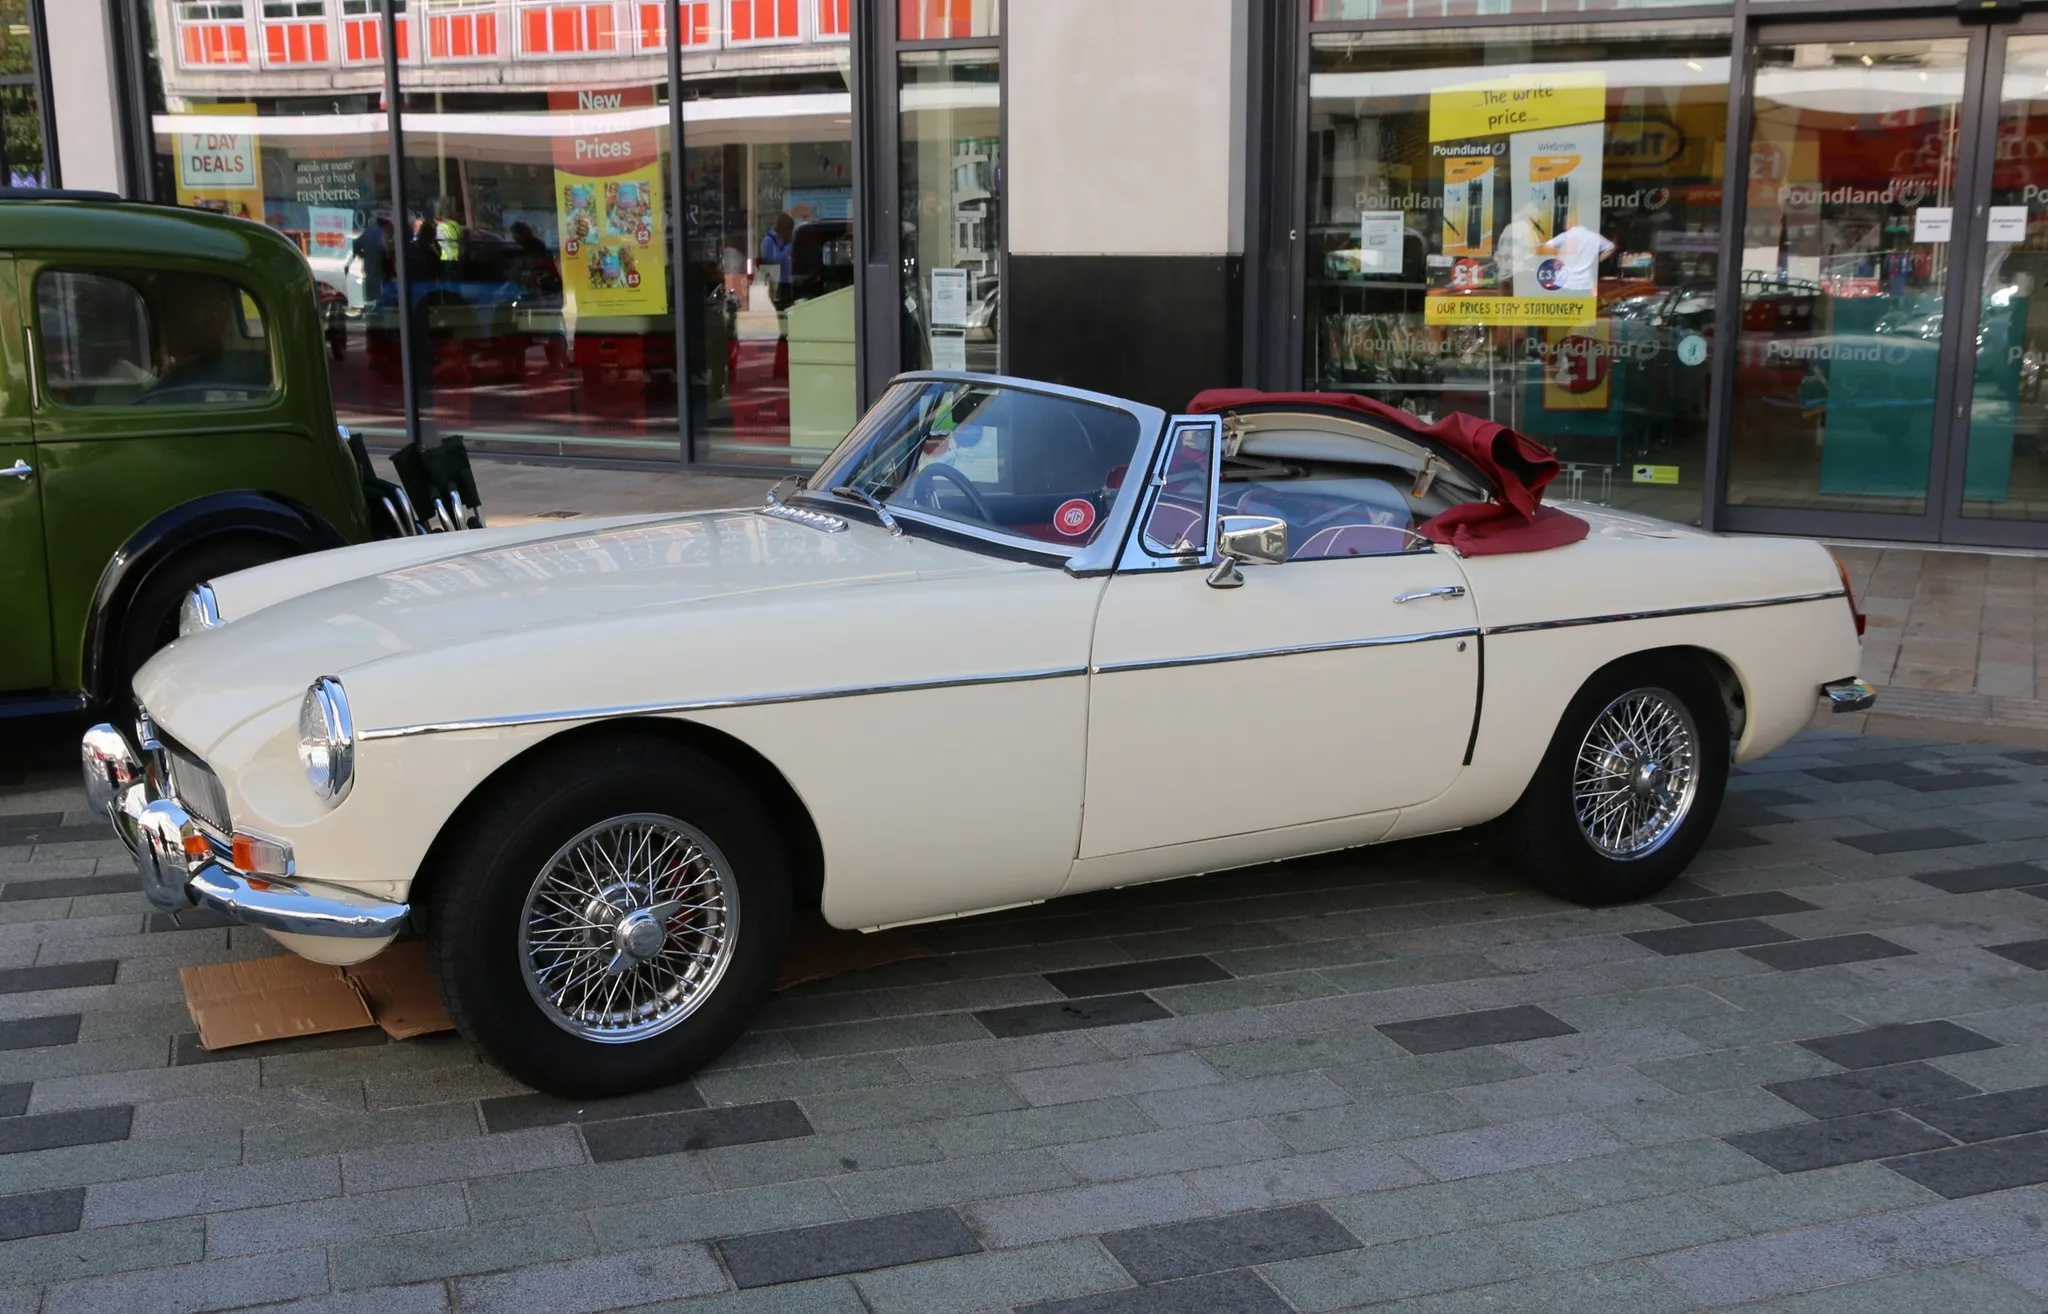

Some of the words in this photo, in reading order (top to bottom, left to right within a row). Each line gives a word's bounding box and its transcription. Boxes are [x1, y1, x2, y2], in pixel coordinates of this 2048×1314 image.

[577, 90, 622, 111] New
[1513, 83, 1554, 101] write
[192, 133, 202, 150] 7
[206, 133, 238, 150] DAY
[575, 137, 632, 159] Prices
[1432, 143, 1490, 156] Poundland
[1537, 141, 1577, 152] WHSmith
[191, 155, 244, 173] DEALS
[296, 172, 312, 185] and
[296, 184, 361, 206] raspberries
[1355, 192, 1444, 210] Poundlan
[1778, 185, 1895, 205] Poundland
[637, 231, 649, 240] £2
[567, 242, 578, 251] £3
[628, 274, 639, 284] £3
[1453, 264, 1480, 285] £1
[1436, 302, 1455, 315] OUR
[1460, 302, 1491, 315] PRICES
[1495, 302, 1521, 315] STAY
[1524, 302, 1584, 315] STATIONERY
[1525, 337, 1631, 357] Poundland
[1766, 340, 1882, 362] Poundland
[1066, 510, 1082, 524] MG
